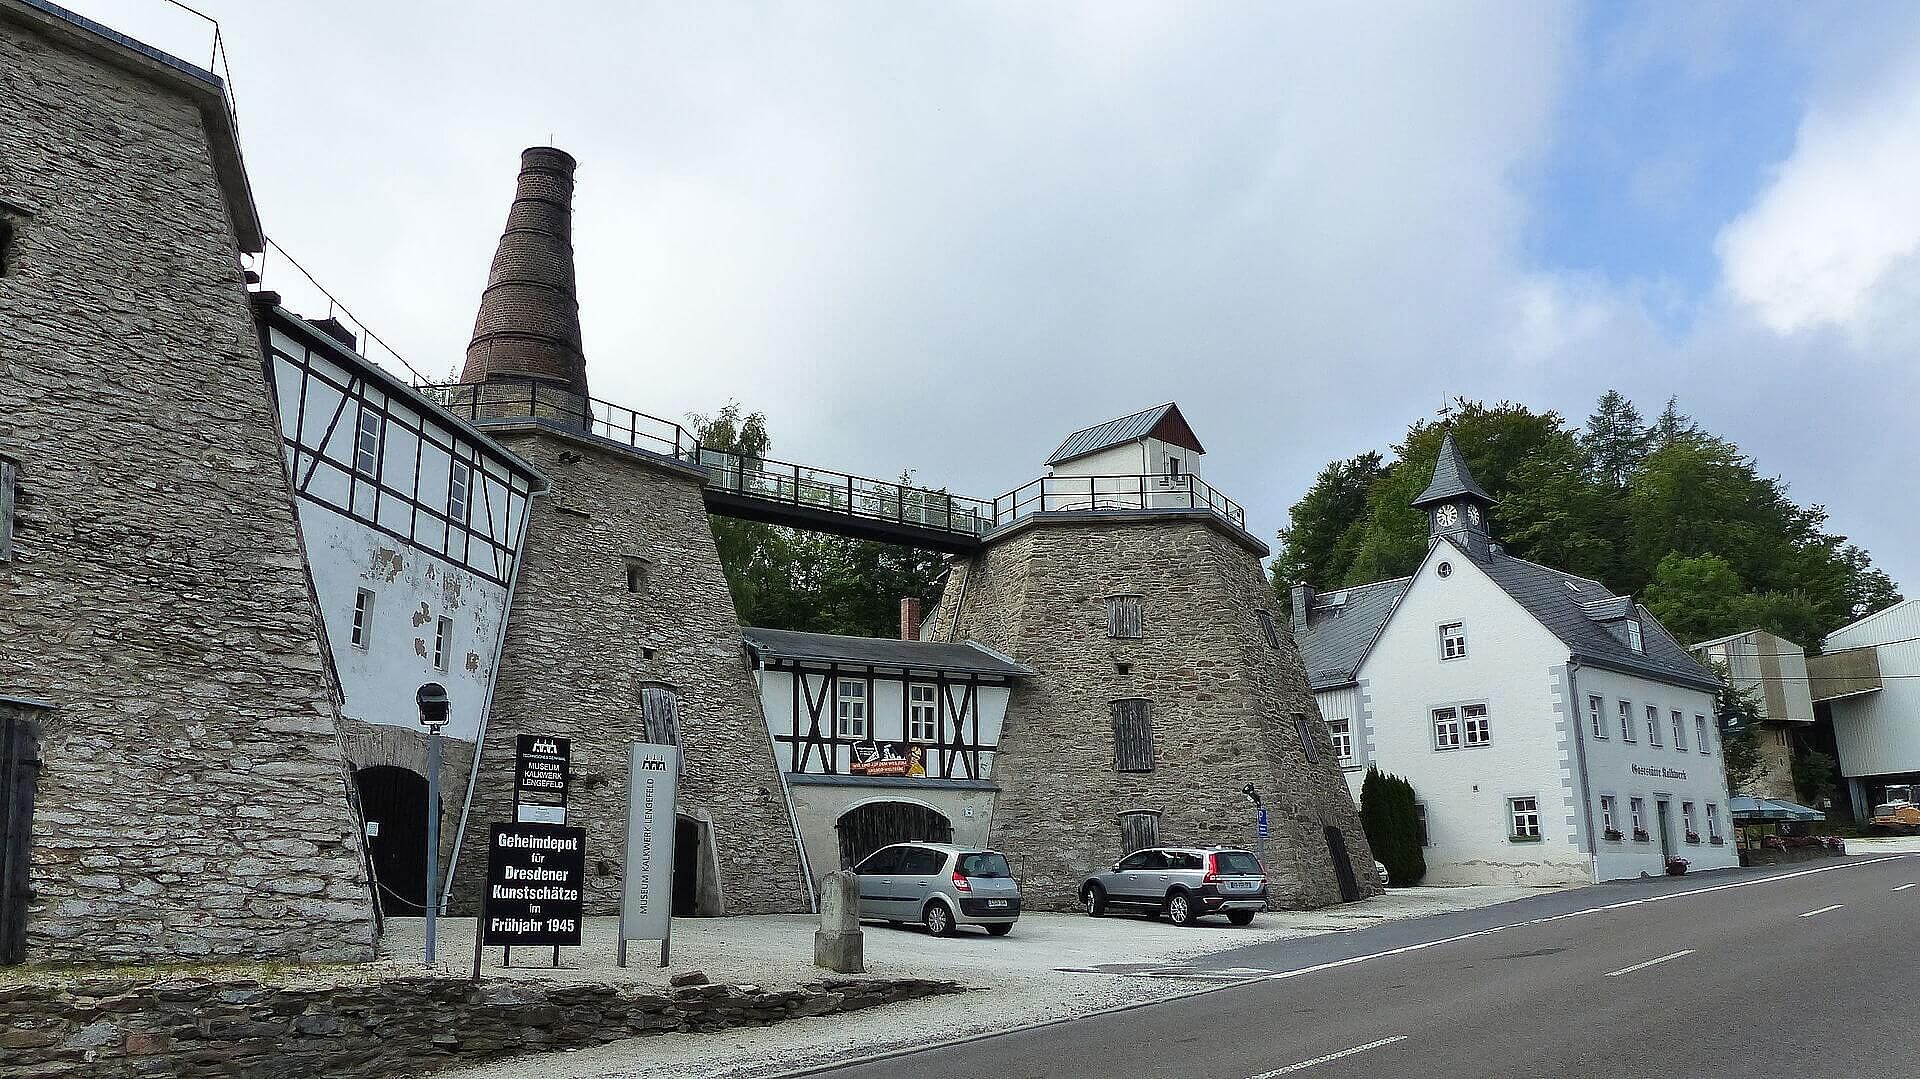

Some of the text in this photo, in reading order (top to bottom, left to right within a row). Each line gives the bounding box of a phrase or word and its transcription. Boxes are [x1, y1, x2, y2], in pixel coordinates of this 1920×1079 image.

[528, 761, 560, 772] MUSEUM
[524, 770, 562, 780] KALKWERK
[522, 778, 564, 789] LENGEFELD
[498, 833, 578, 852] Geheimdepot
[639, 778, 655, 915] MUSEUM KALKWERK LENGEFELD
[531, 852, 546, 864] für
[504, 865, 569, 882] Dresdener
[492, 884, 578, 901] Kunstschätze
[529, 903, 541, 914] im
[491, 917, 575, 935] Frühjahr 1945
